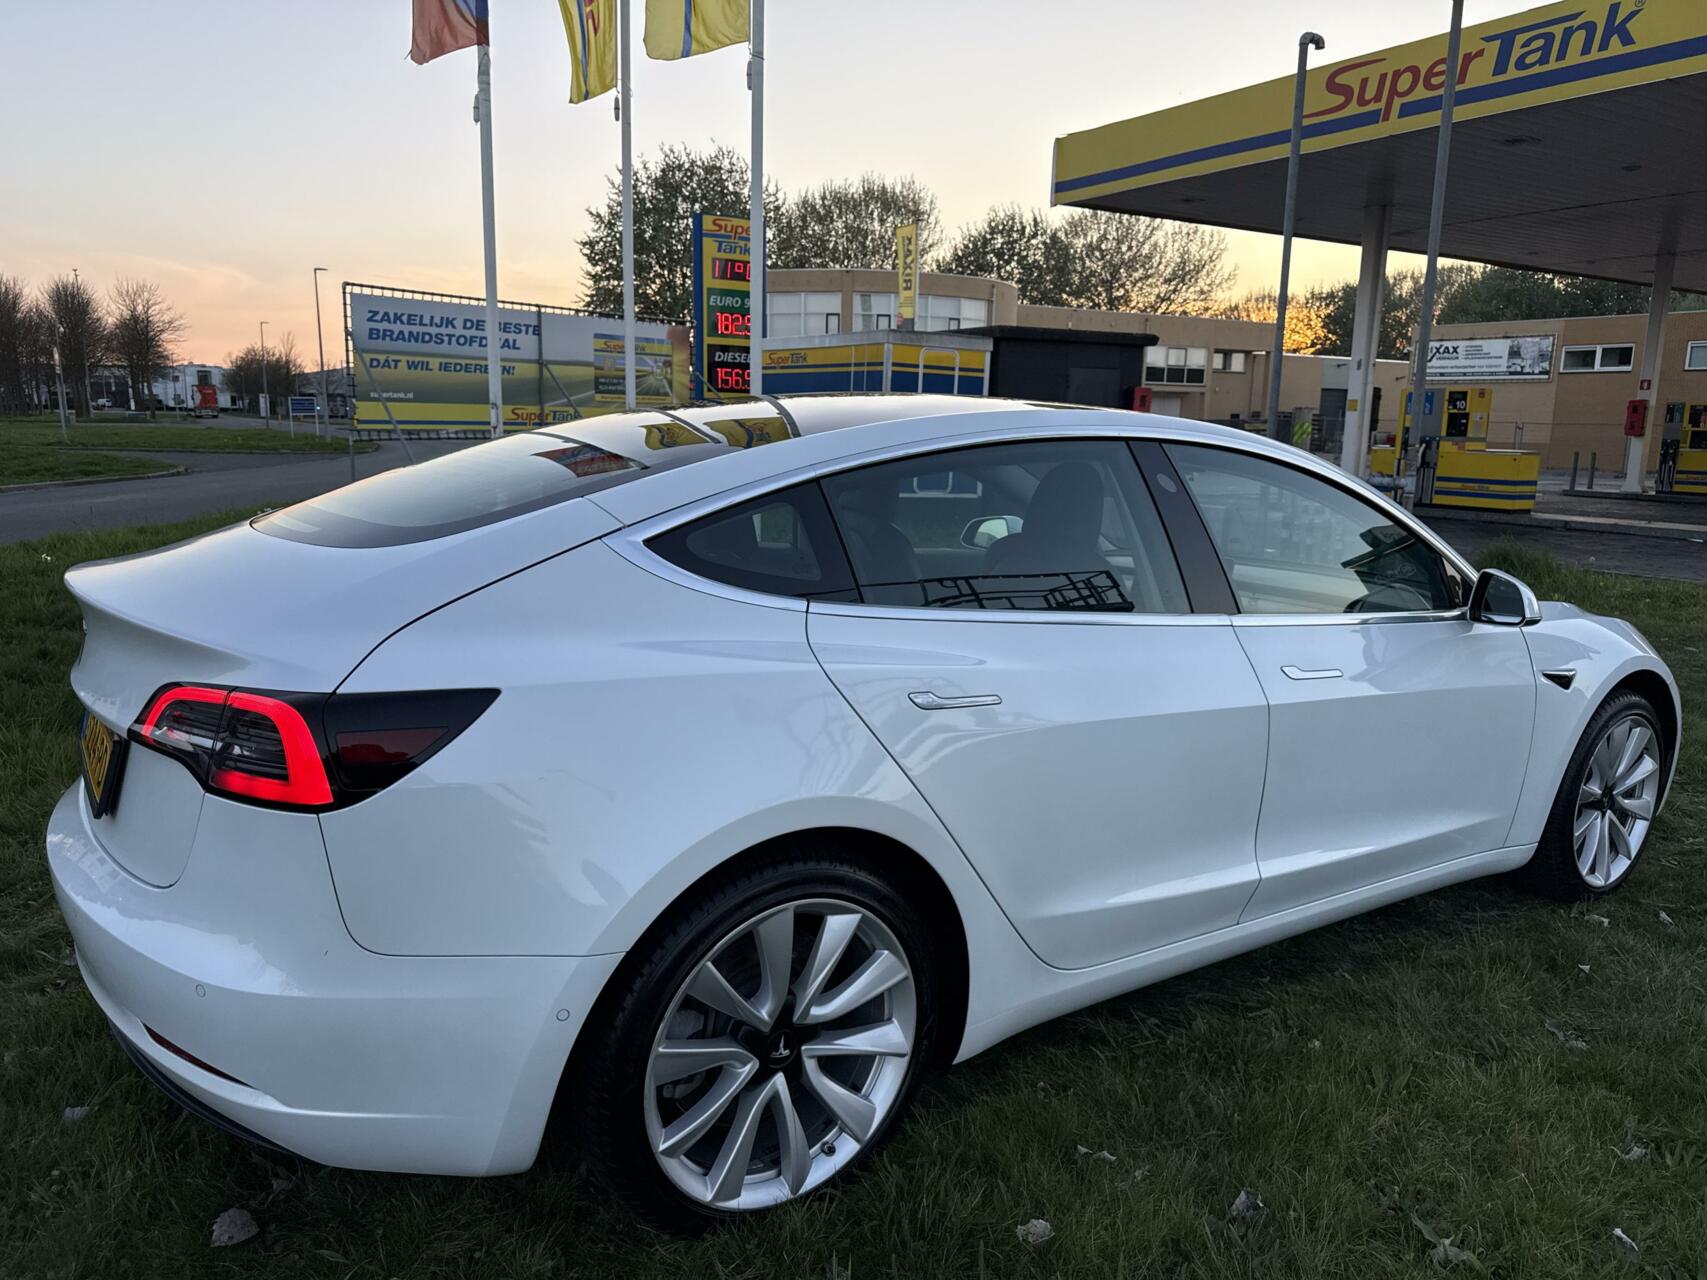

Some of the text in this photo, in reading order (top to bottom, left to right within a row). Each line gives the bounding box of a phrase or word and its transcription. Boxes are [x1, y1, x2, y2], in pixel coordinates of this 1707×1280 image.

[1303, 1, 1645, 122] SuperTank
[704, 218, 751, 240] Supe
[709, 295, 741, 307] EURO
[366, 310, 541, 336] ZAKELIJK DE ESTE
[368, 328, 521, 350] BRANDSTOFDAL
[369, 355, 516, 376] DÁT WIL IEDEREN!
[1456, 400, 1466, 409] 10
